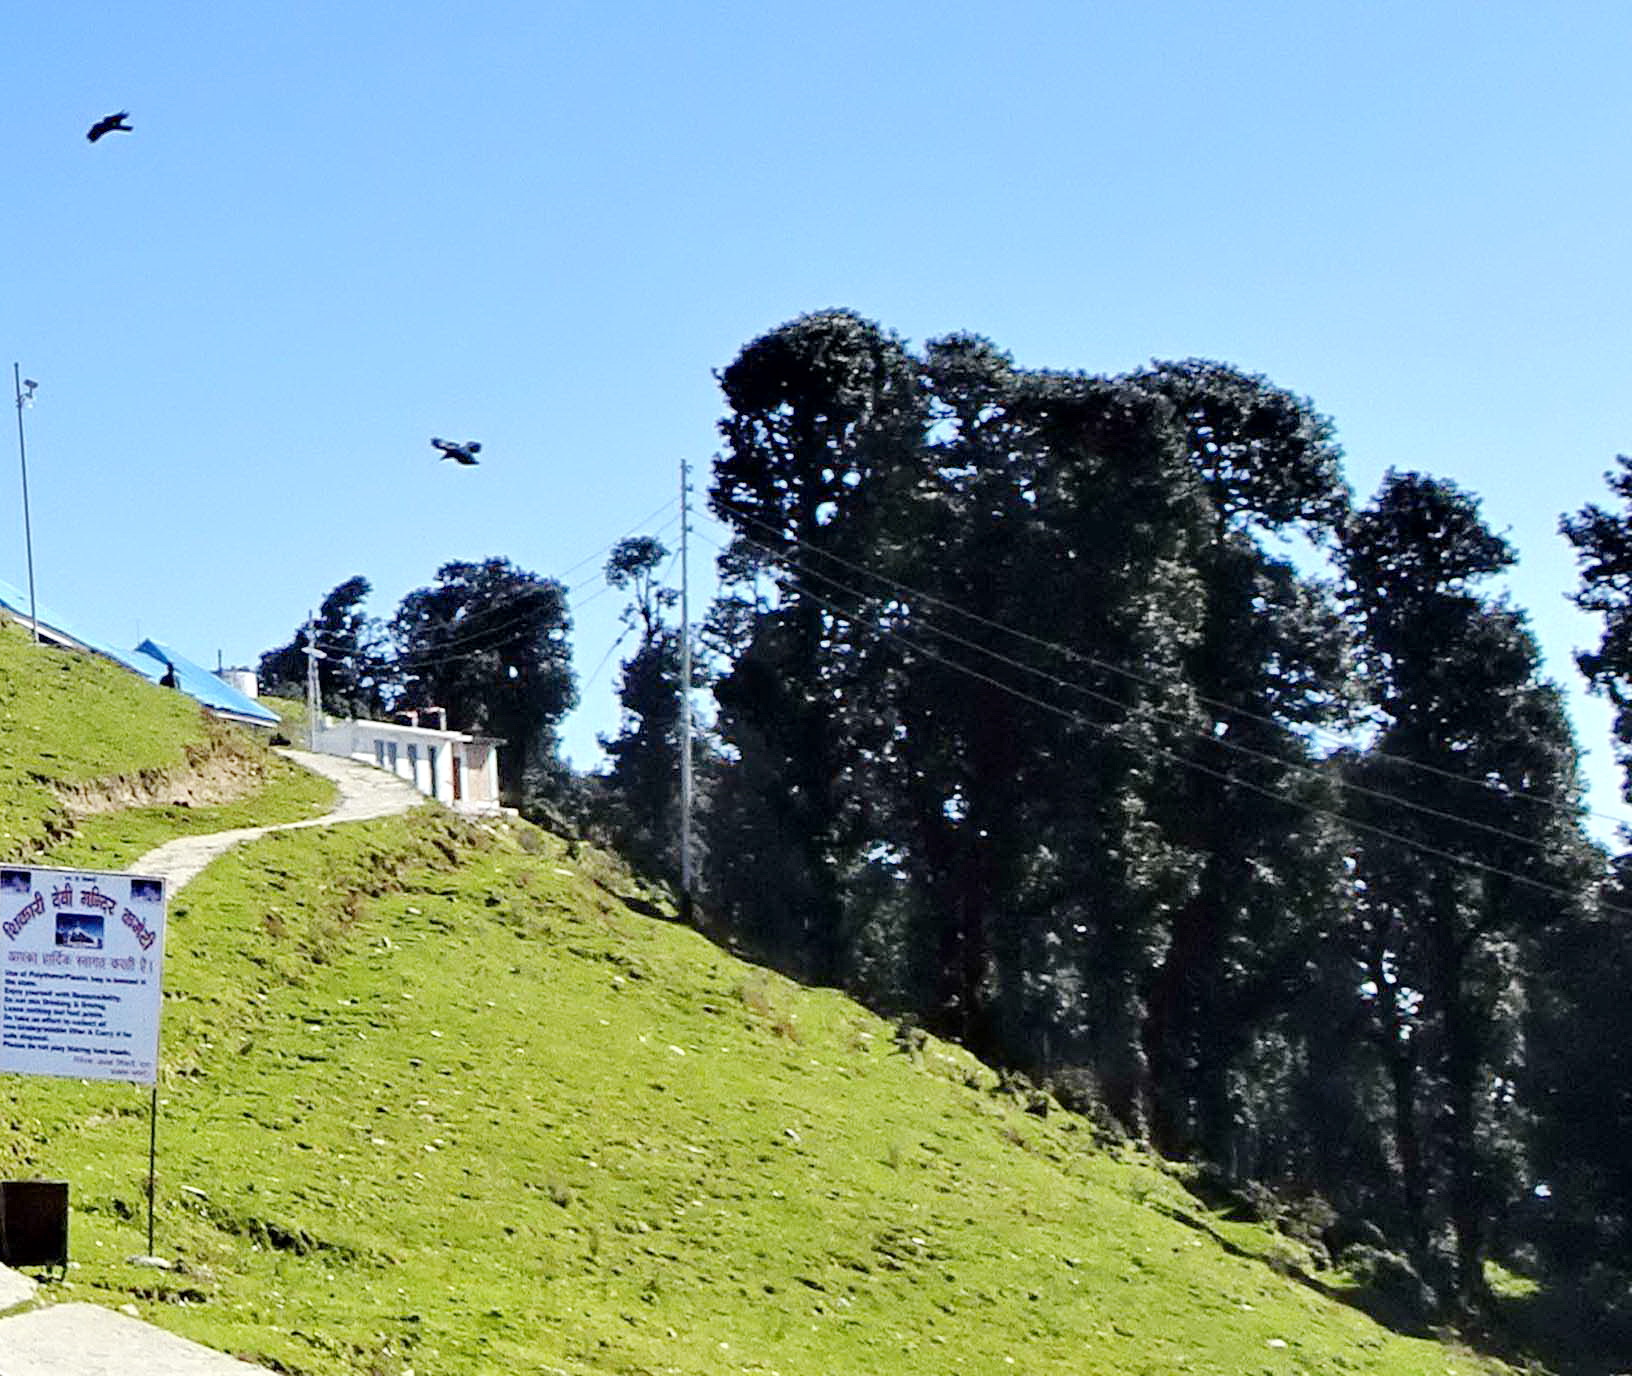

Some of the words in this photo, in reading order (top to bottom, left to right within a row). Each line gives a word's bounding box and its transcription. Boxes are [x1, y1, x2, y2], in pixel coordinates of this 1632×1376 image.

[3, 891, 46, 941] शिकारी
[51, 882, 73, 909] देवी
[80, 885, 117, 915] मन्दिर
[121, 907, 156, 951] कमेटी
[76, 954, 105, 969] स्वागत
